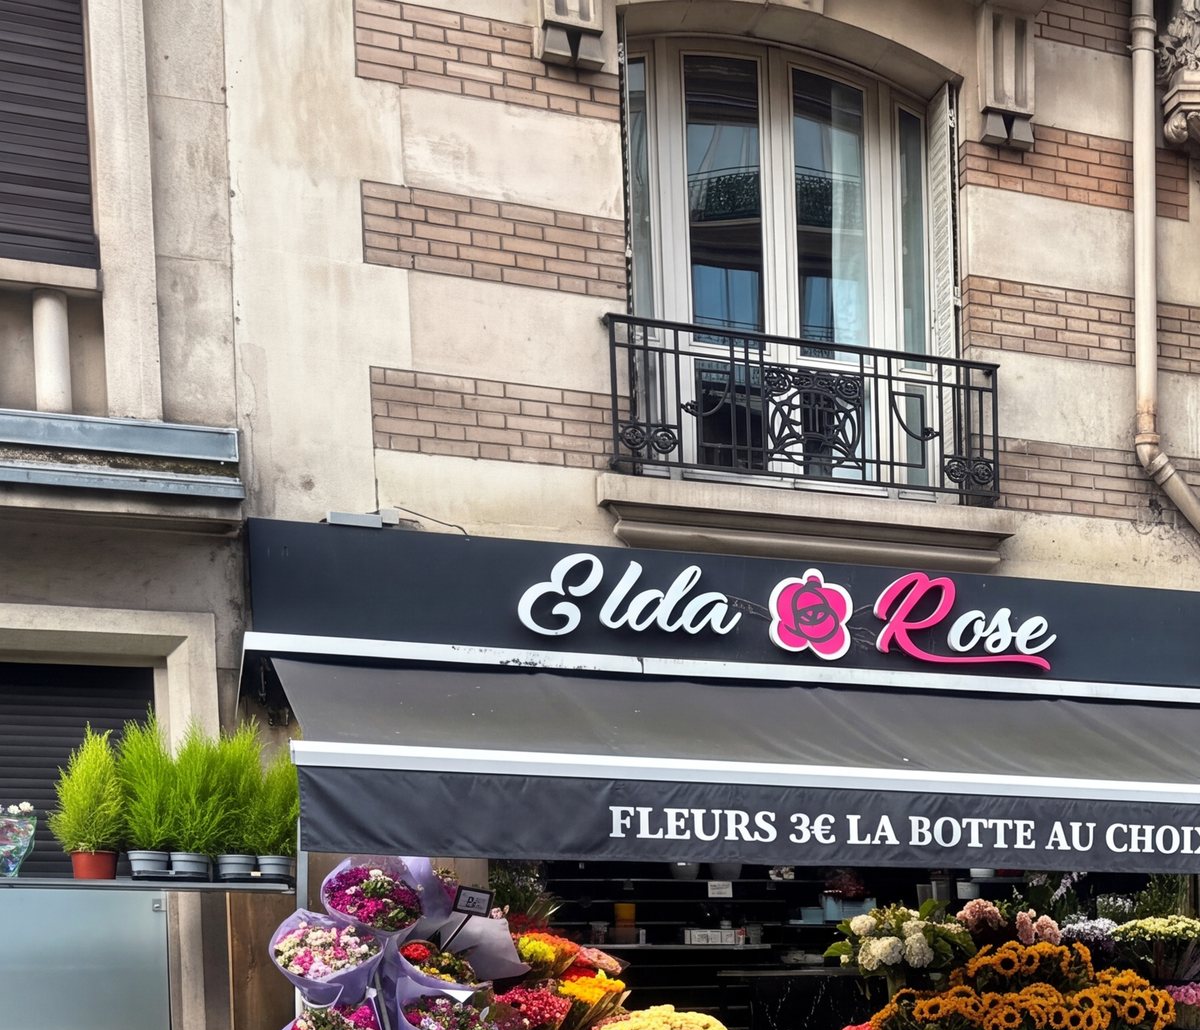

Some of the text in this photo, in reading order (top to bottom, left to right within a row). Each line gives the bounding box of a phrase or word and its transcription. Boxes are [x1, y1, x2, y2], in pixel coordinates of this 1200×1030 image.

[517, 552, 1058, 672] Elda Rose
[608, 805, 778, 843] FLEURS
[788, 812, 837, 845] 3€
[845, 813, 900, 846] LA
[908, 815, 1036, 849] BOTTE
[1045, 820, 1097, 852] AU
